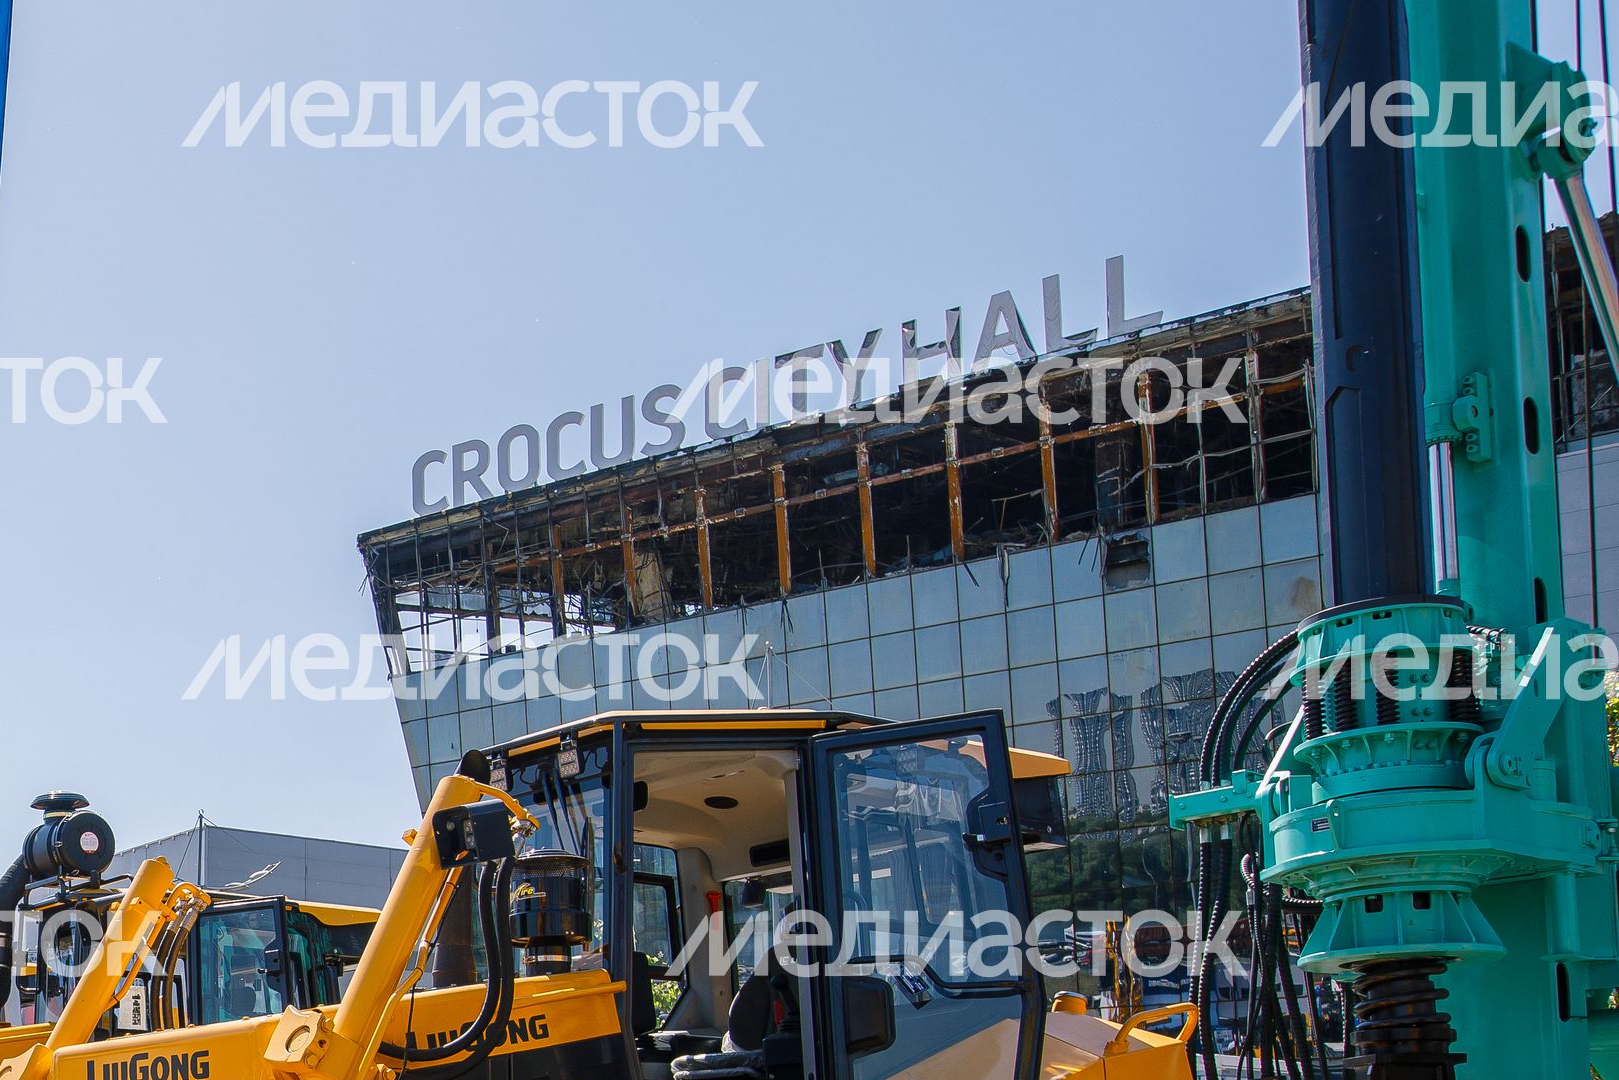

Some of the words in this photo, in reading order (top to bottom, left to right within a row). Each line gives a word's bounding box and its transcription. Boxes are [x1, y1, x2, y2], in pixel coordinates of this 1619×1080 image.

[410, 383, 686, 518] CROCUS
[702, 328, 883, 440] CITY
[901, 253, 1165, 388] HALL
